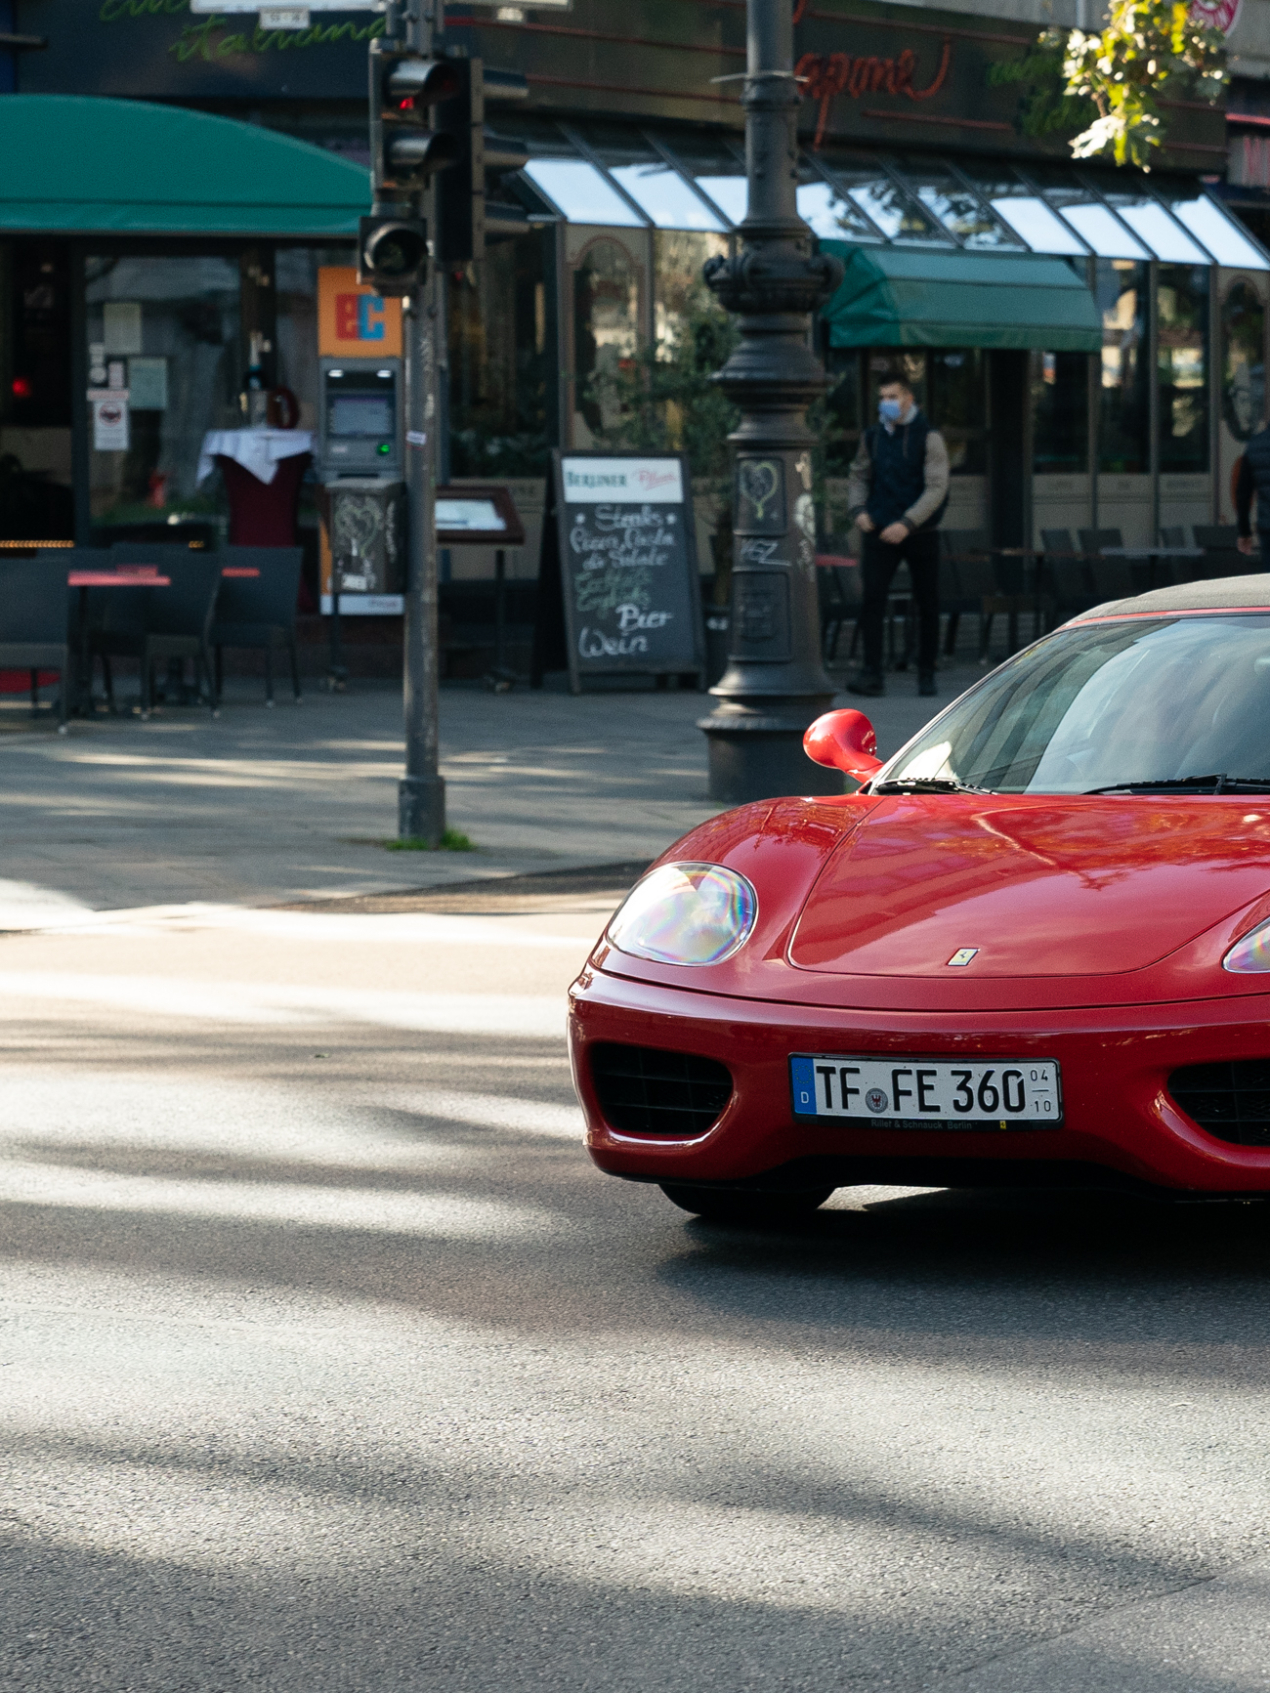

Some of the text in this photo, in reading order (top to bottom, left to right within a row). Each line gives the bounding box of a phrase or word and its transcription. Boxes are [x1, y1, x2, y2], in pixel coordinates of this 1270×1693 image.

[567, 471, 628, 488] BERLINER
[615, 602, 674, 631] Bier
[578, 627, 649, 658] Wein
[1030, 1069, 1049, 1081] 04
[816, 1065, 861, 1110] TF
[951, 1069, 1026, 1113] 360
[800, 1091, 810, 1104] D
[1034, 1100, 1052, 1112] 10
[894, 1120, 901, 1128] &
[902, 1119, 943, 1130] Schnauck
[947, 1120, 972, 1130] Berlin
